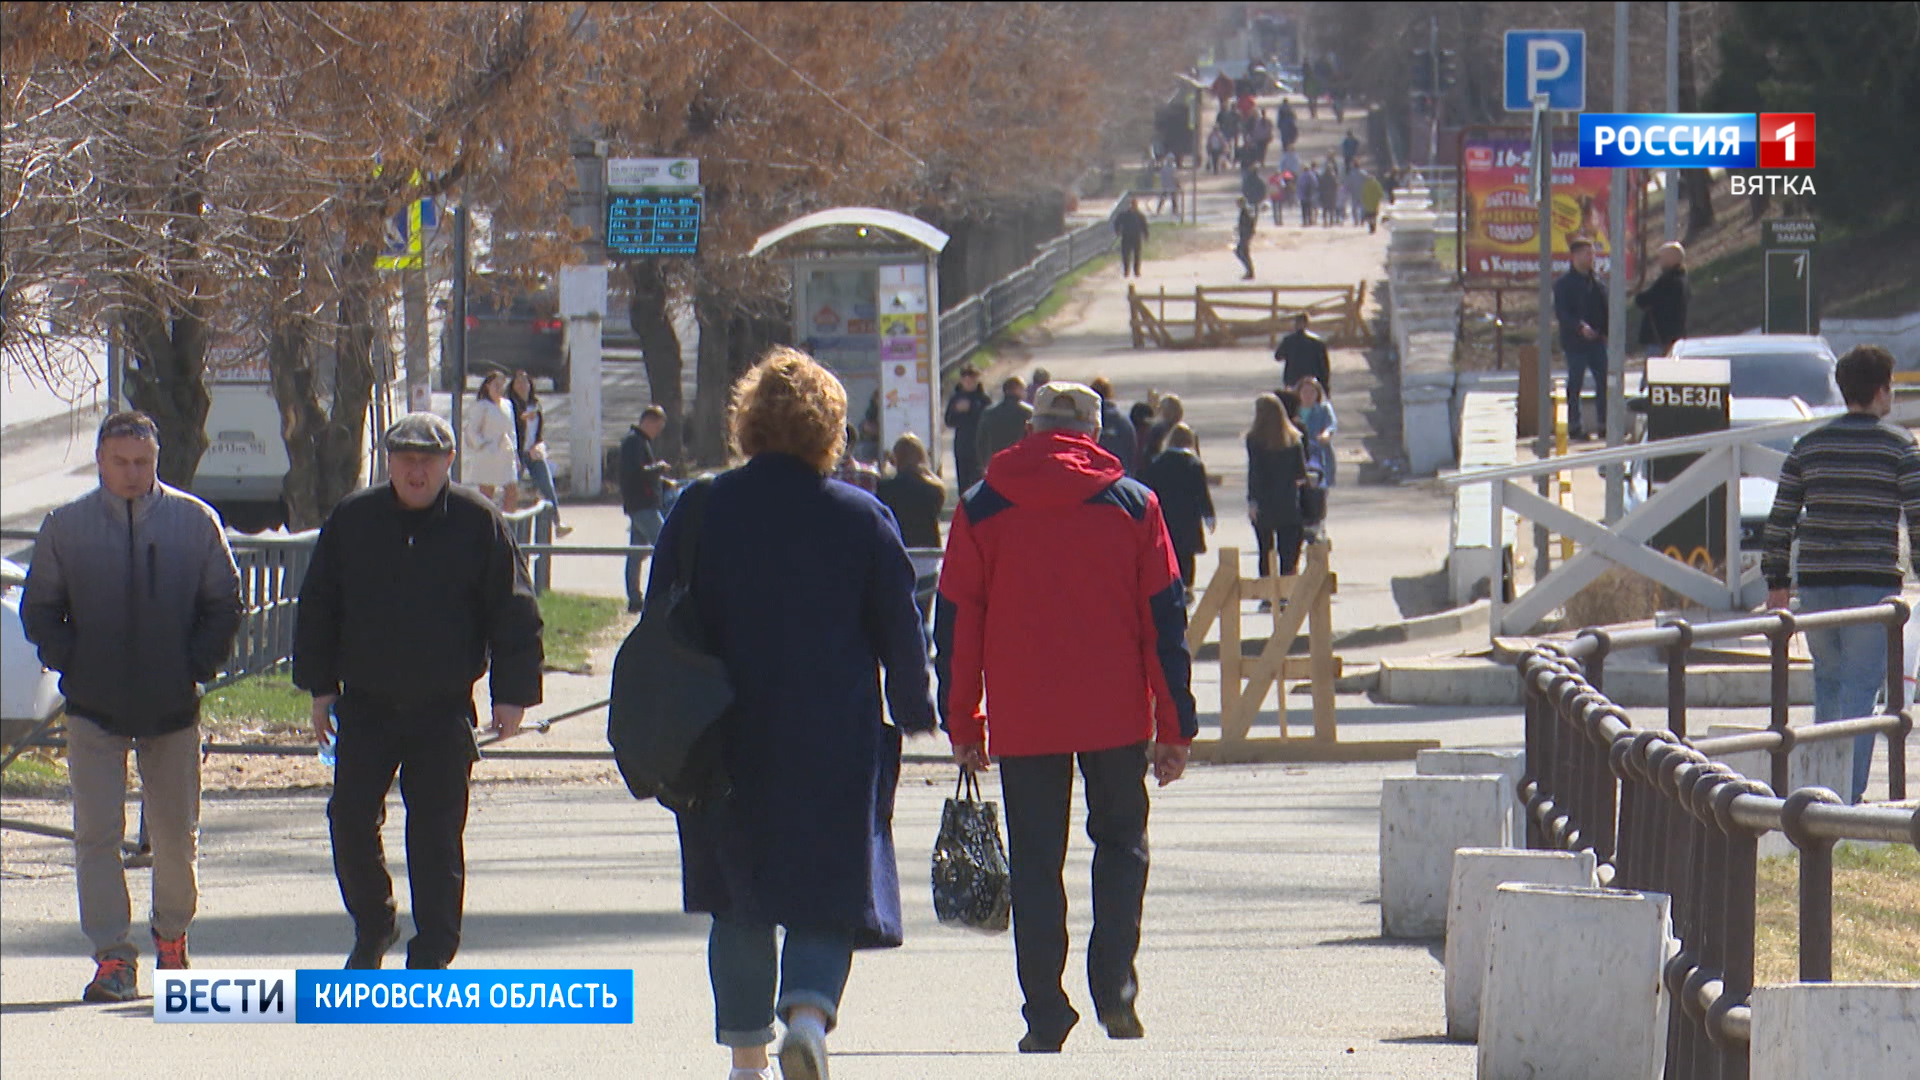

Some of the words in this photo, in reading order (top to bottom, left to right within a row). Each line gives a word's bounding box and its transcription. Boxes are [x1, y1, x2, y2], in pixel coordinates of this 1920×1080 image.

[1528, 40, 1570, 102] P
[1794, 254, 1805, 279] 1
[1651, 387, 1722, 409] ВЪЕЗД
